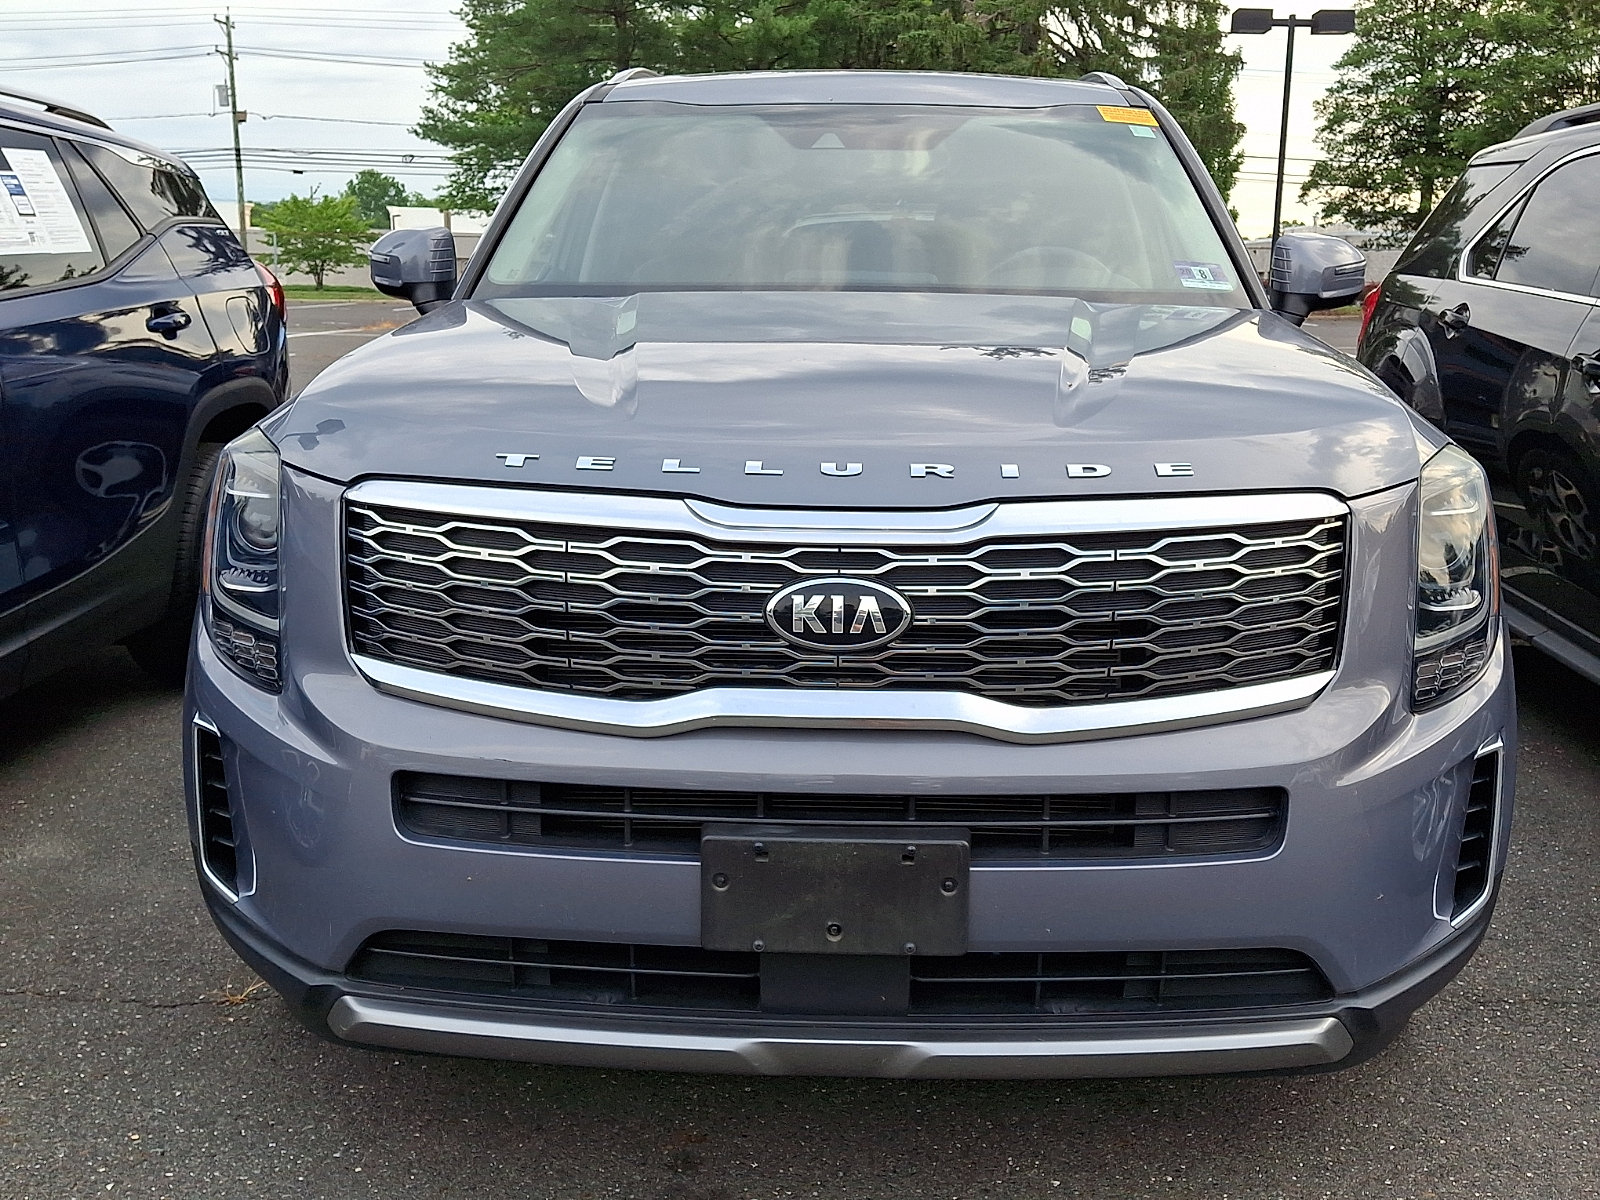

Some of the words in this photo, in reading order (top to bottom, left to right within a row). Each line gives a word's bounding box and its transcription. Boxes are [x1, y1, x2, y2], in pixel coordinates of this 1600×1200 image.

[1198, 269, 1207, 279] 8
[496, 453, 1195, 477] TELLURIDE
[791, 594, 887, 634] KIA
